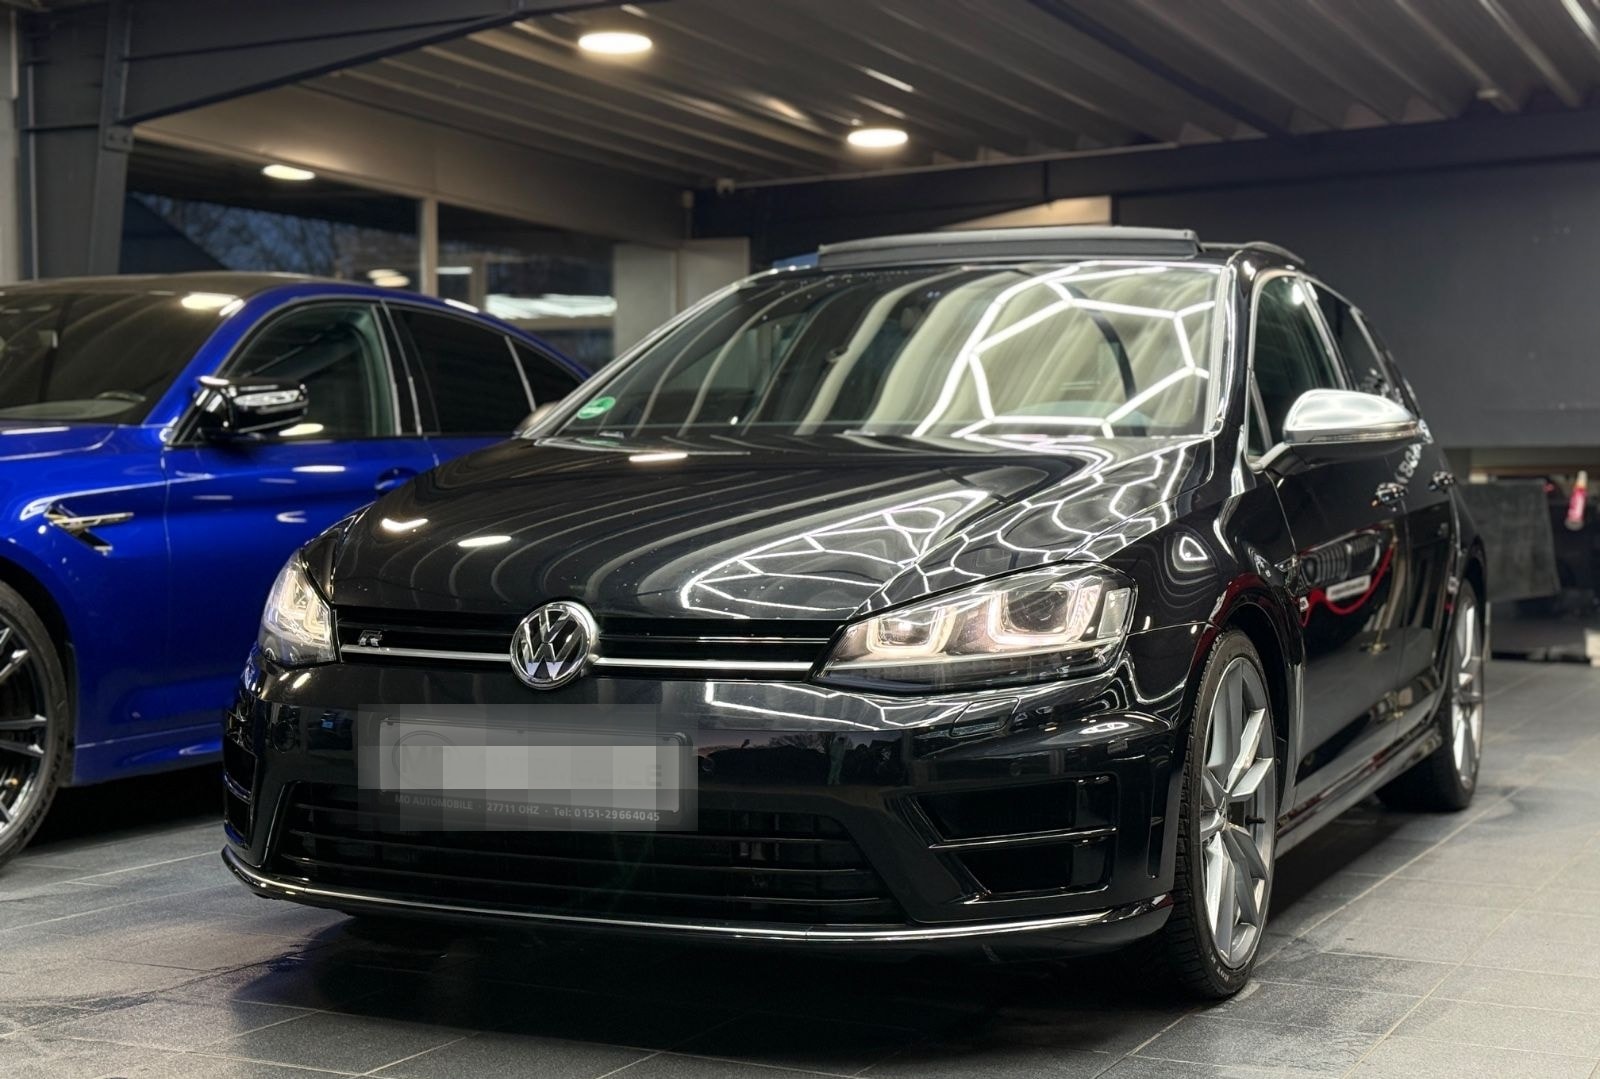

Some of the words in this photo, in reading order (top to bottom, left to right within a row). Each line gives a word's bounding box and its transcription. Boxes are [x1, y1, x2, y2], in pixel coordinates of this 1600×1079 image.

[413, 796, 473, 810] AUTOMOBILE
[487, 802, 515, 813] 27711
[518, 804, 540, 815] OHZ
[553, 807, 572, 817] Tel:
[574, 808, 660, 822] 0151-29664045
